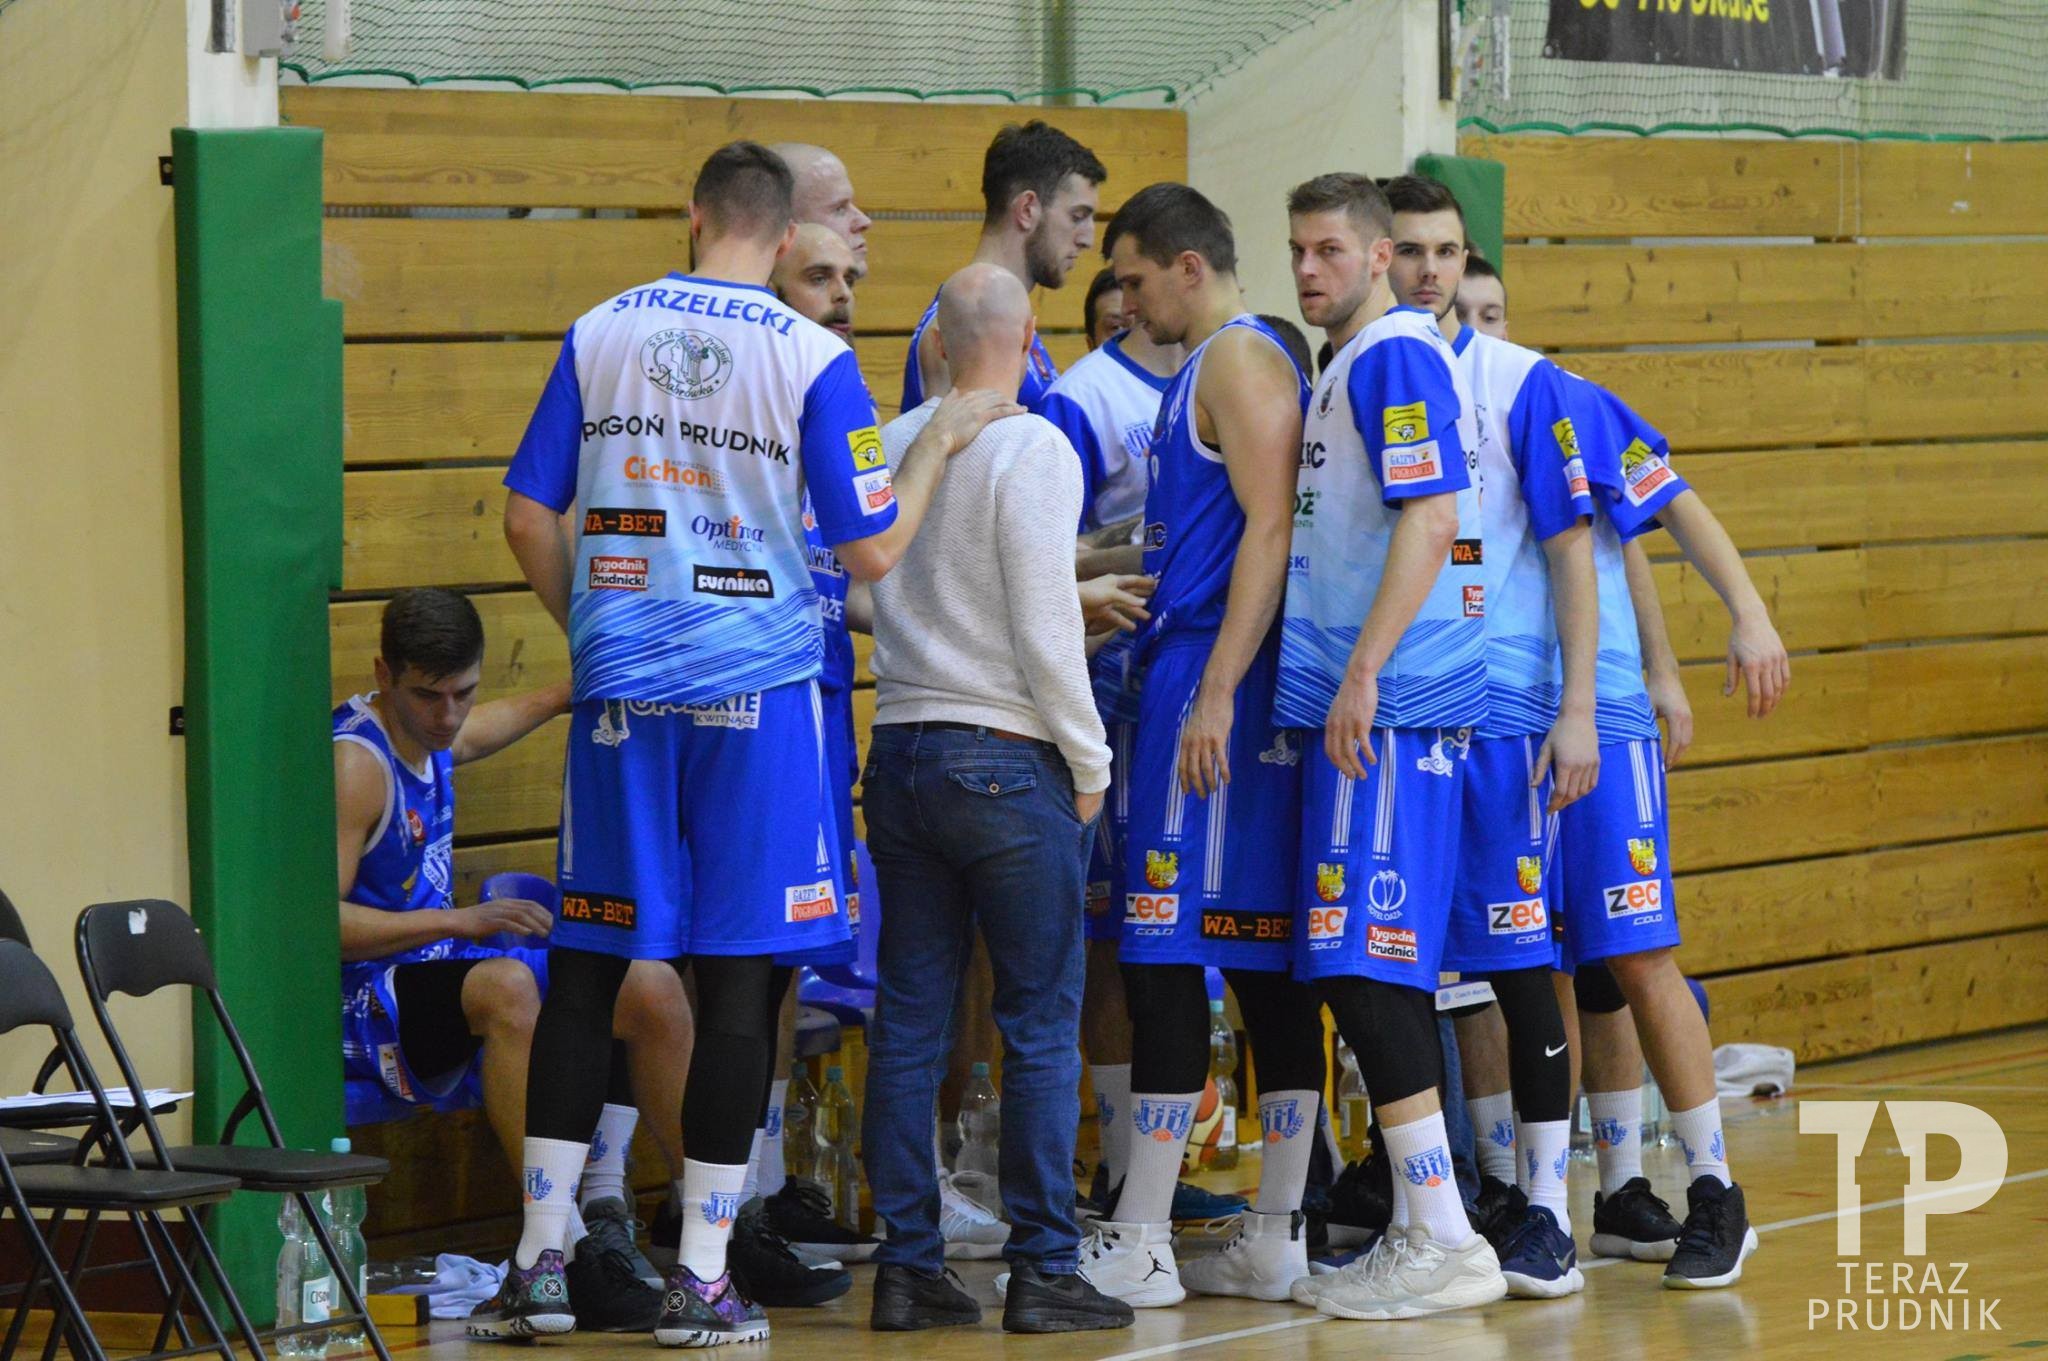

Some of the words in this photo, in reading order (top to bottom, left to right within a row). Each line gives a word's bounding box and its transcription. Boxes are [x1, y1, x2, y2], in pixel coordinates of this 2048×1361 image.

[613, 288, 797, 337] STRZELECKI
[680, 421, 790, 465] PRUDNIK
[593, 558, 647, 572] Tygodnik
[593, 574, 646, 586] Prudnicki
[697, 568, 769, 592] furnika
[696, 713, 757, 729] KWITNĄCE
[563, 896, 634, 925] WA-BET
[1608, 882, 1659, 913] zec
[1491, 901, 1544, 929] zec
